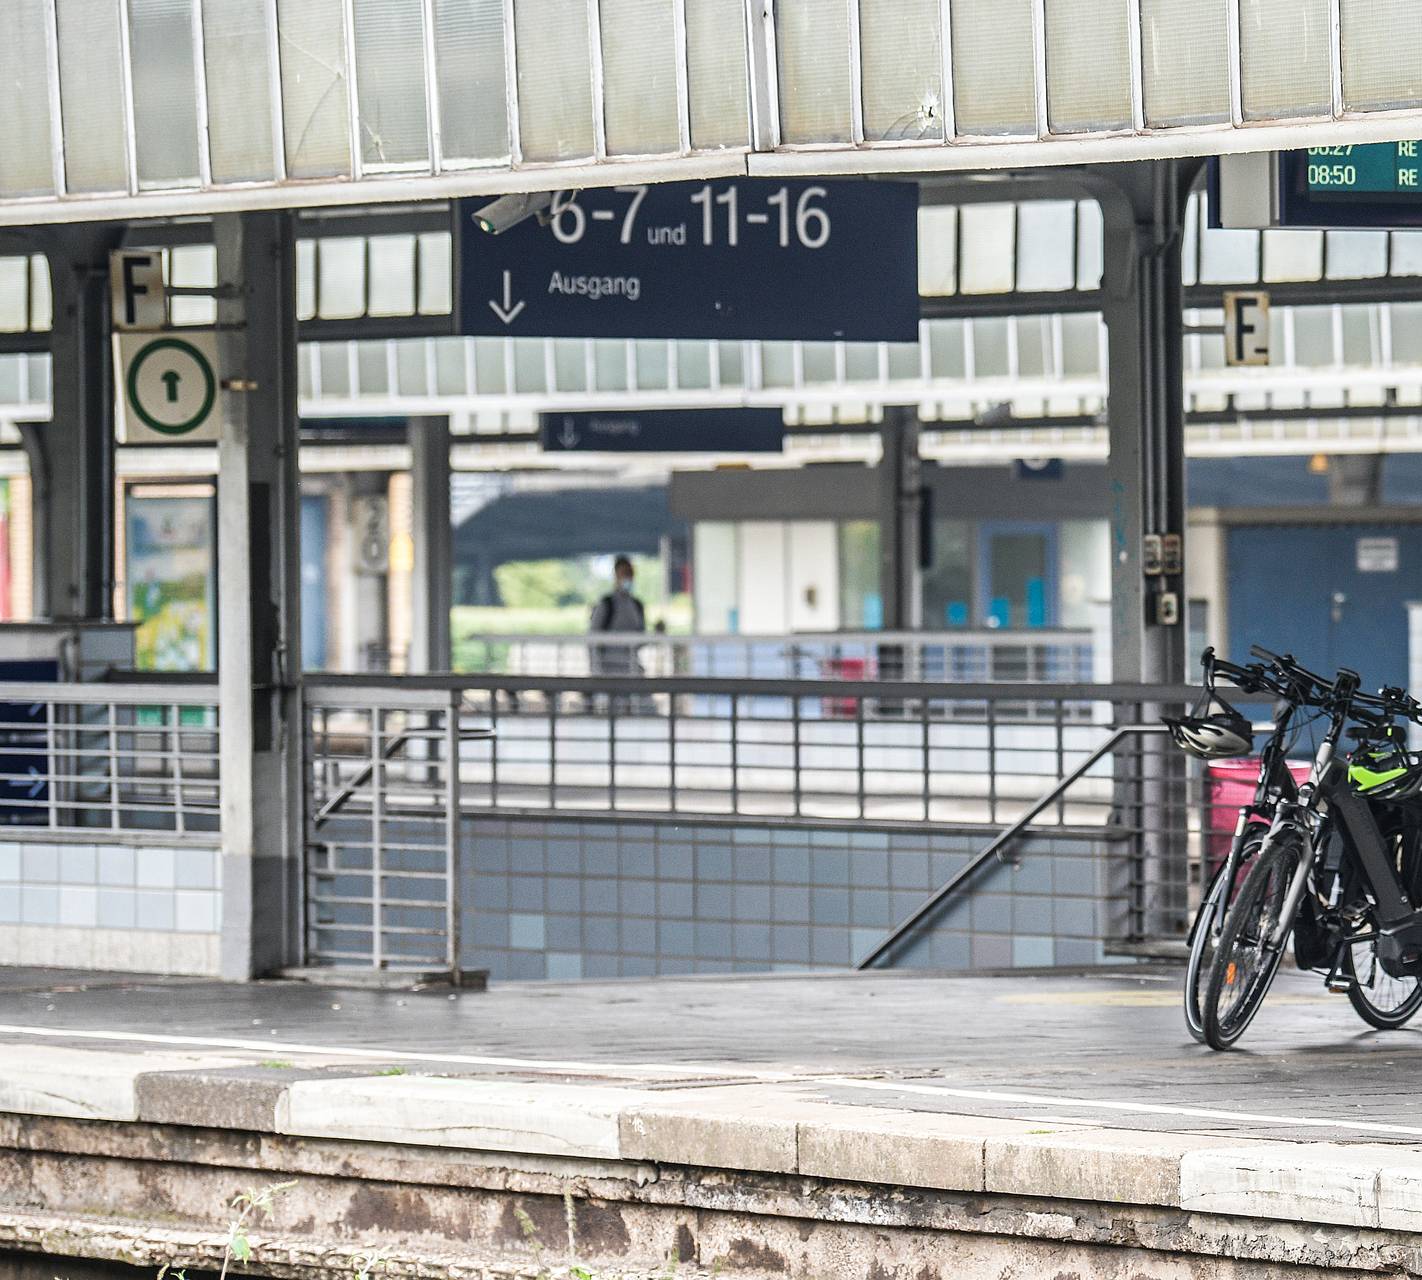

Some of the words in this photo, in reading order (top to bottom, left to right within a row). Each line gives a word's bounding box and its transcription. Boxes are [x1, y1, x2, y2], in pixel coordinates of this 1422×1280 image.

[1398, 141, 1418, 157] RE
[1307, 165, 1356, 185] 08:50
[1398, 169, 1418, 186] RE
[551, 185, 648, 244] 6-7
[647, 222, 687, 246] und
[690, 185, 831, 249] 11-16
[123, 256, 151, 323] F
[548, 270, 641, 301] Ausgang
